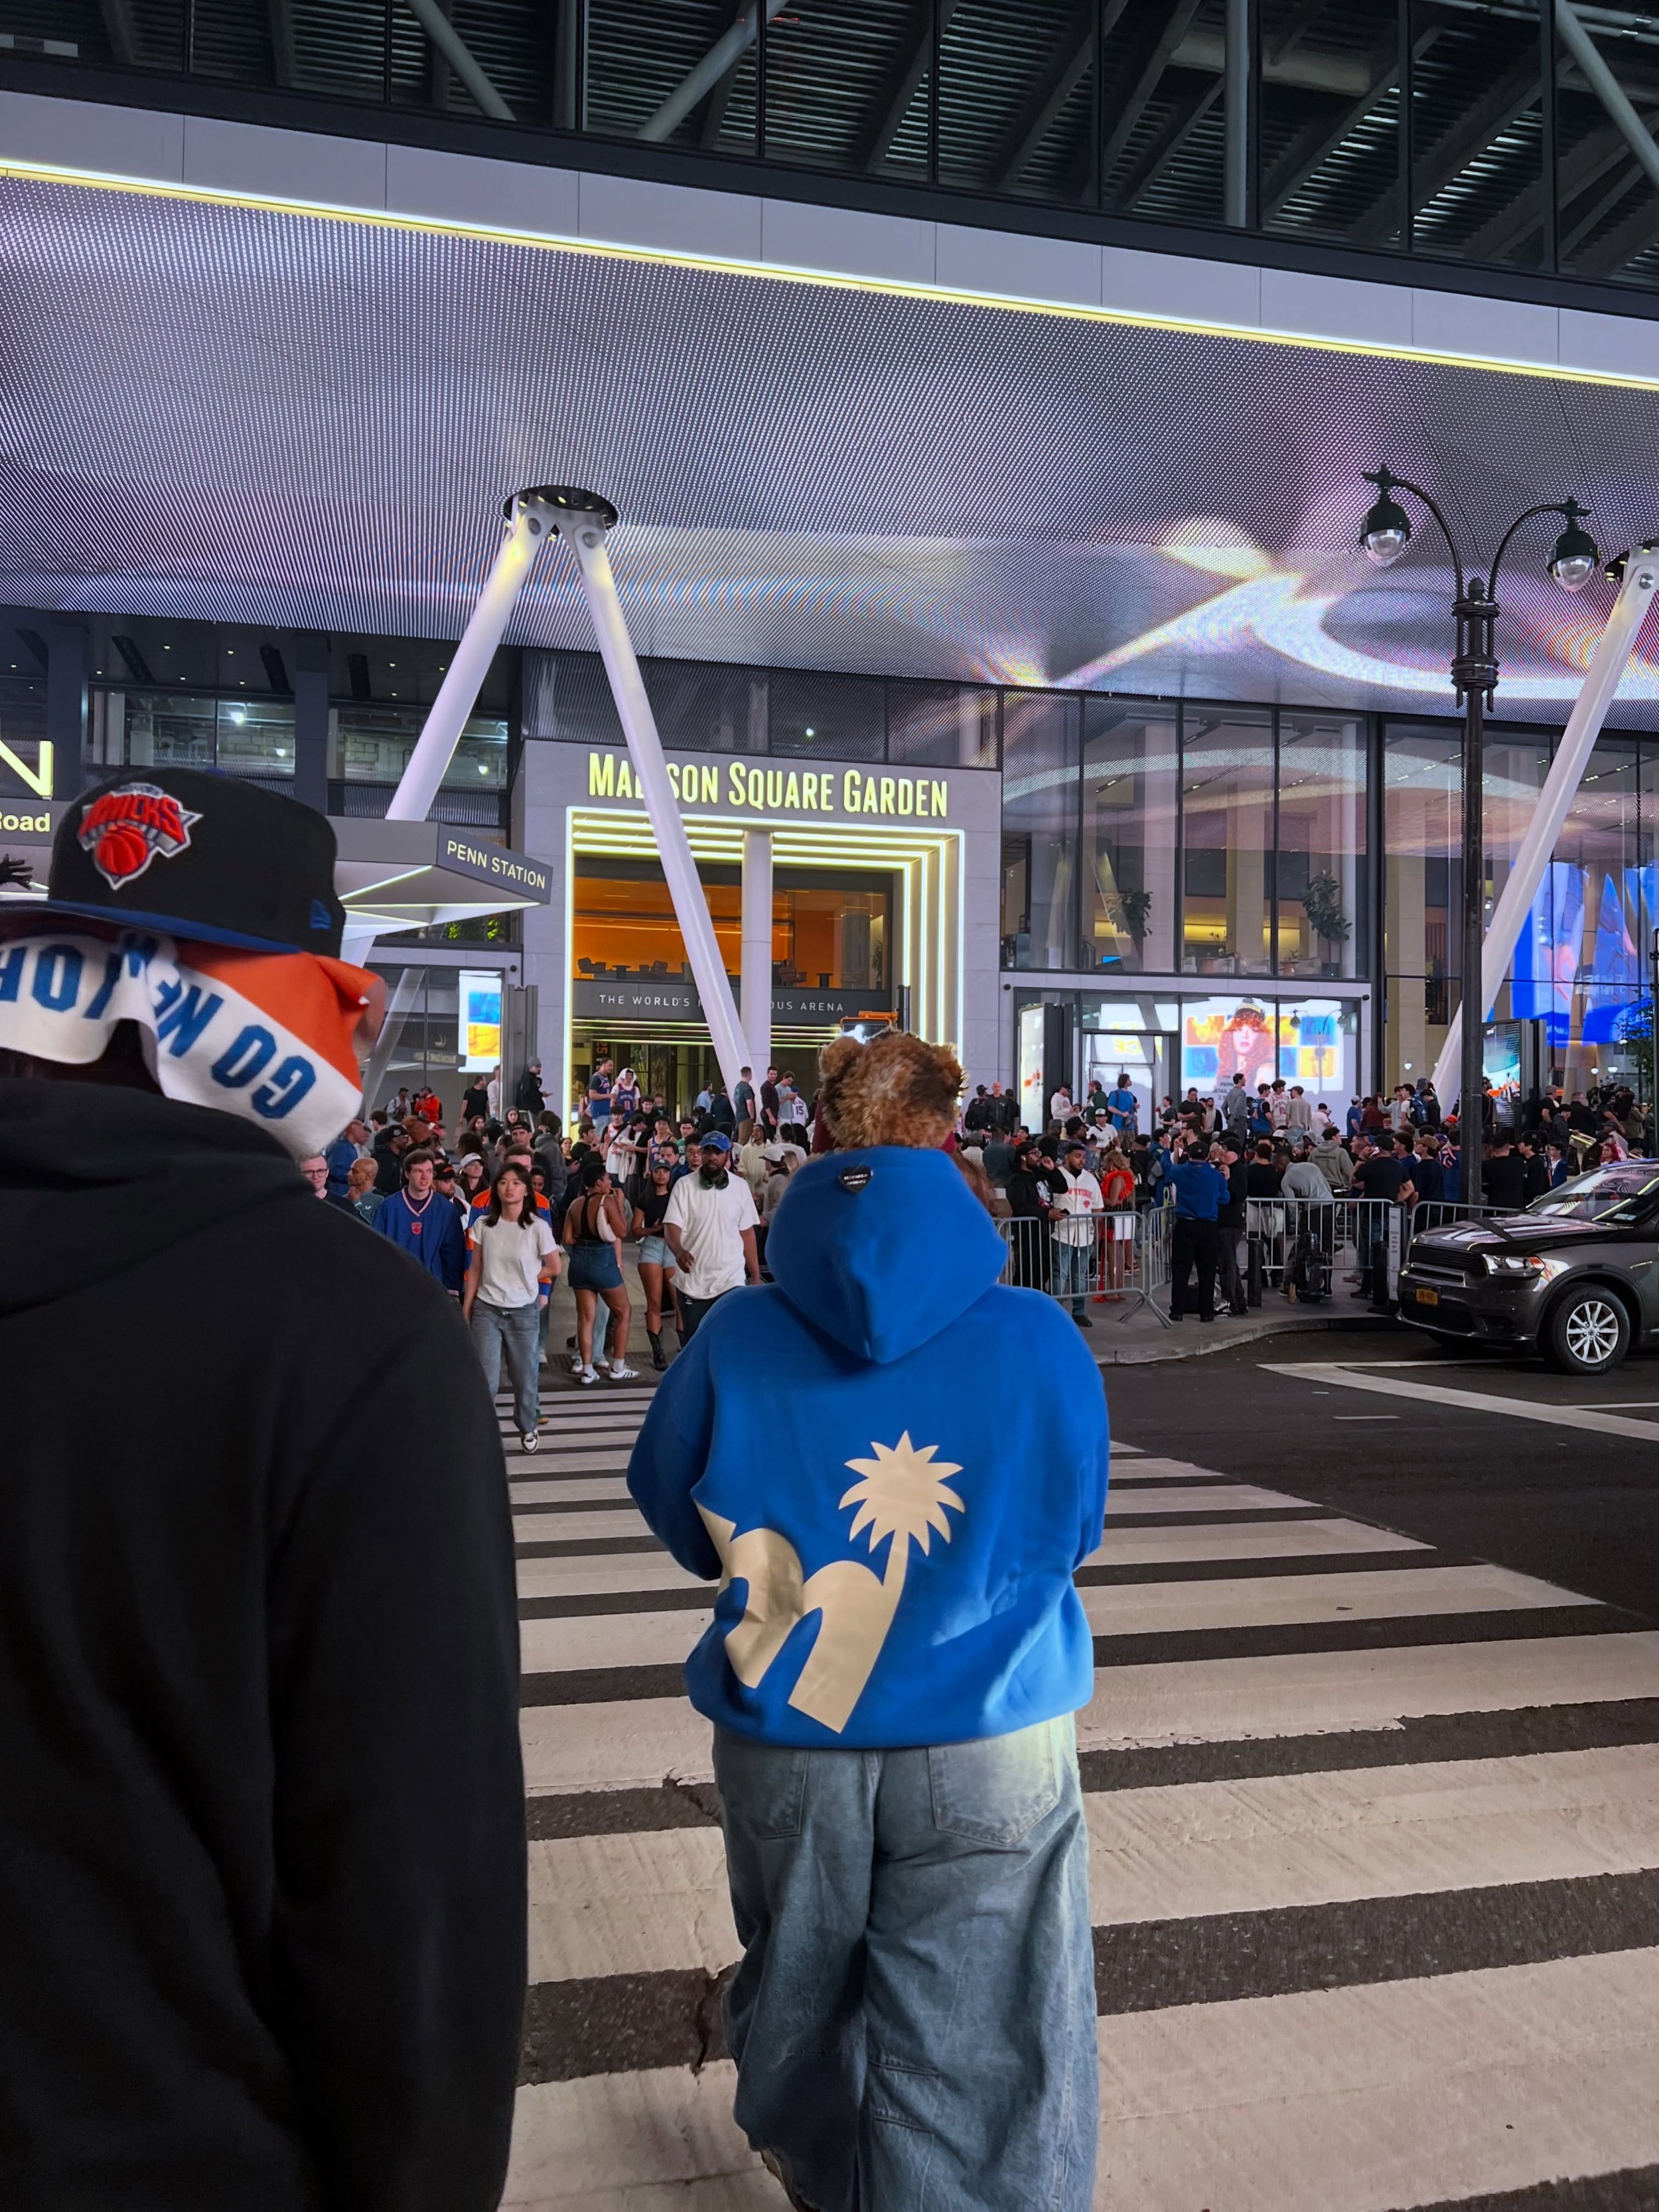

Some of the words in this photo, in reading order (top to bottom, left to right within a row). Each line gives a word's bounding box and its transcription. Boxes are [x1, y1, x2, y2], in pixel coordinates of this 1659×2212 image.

[589, 753, 718, 803] MASON
[729, 762, 834, 810] SQUARE
[843, 769, 948, 817] GARDEN
[0, 811, 50, 832] oad
[447, 840, 487, 869] PENN
[491, 857, 546, 890] STATION
[599, 994, 625, 1005] THE
[632, 995, 690, 1007] WORLD'S
[800, 1001, 844, 1012] ARENA
[796, 1105, 804, 1116] 15
